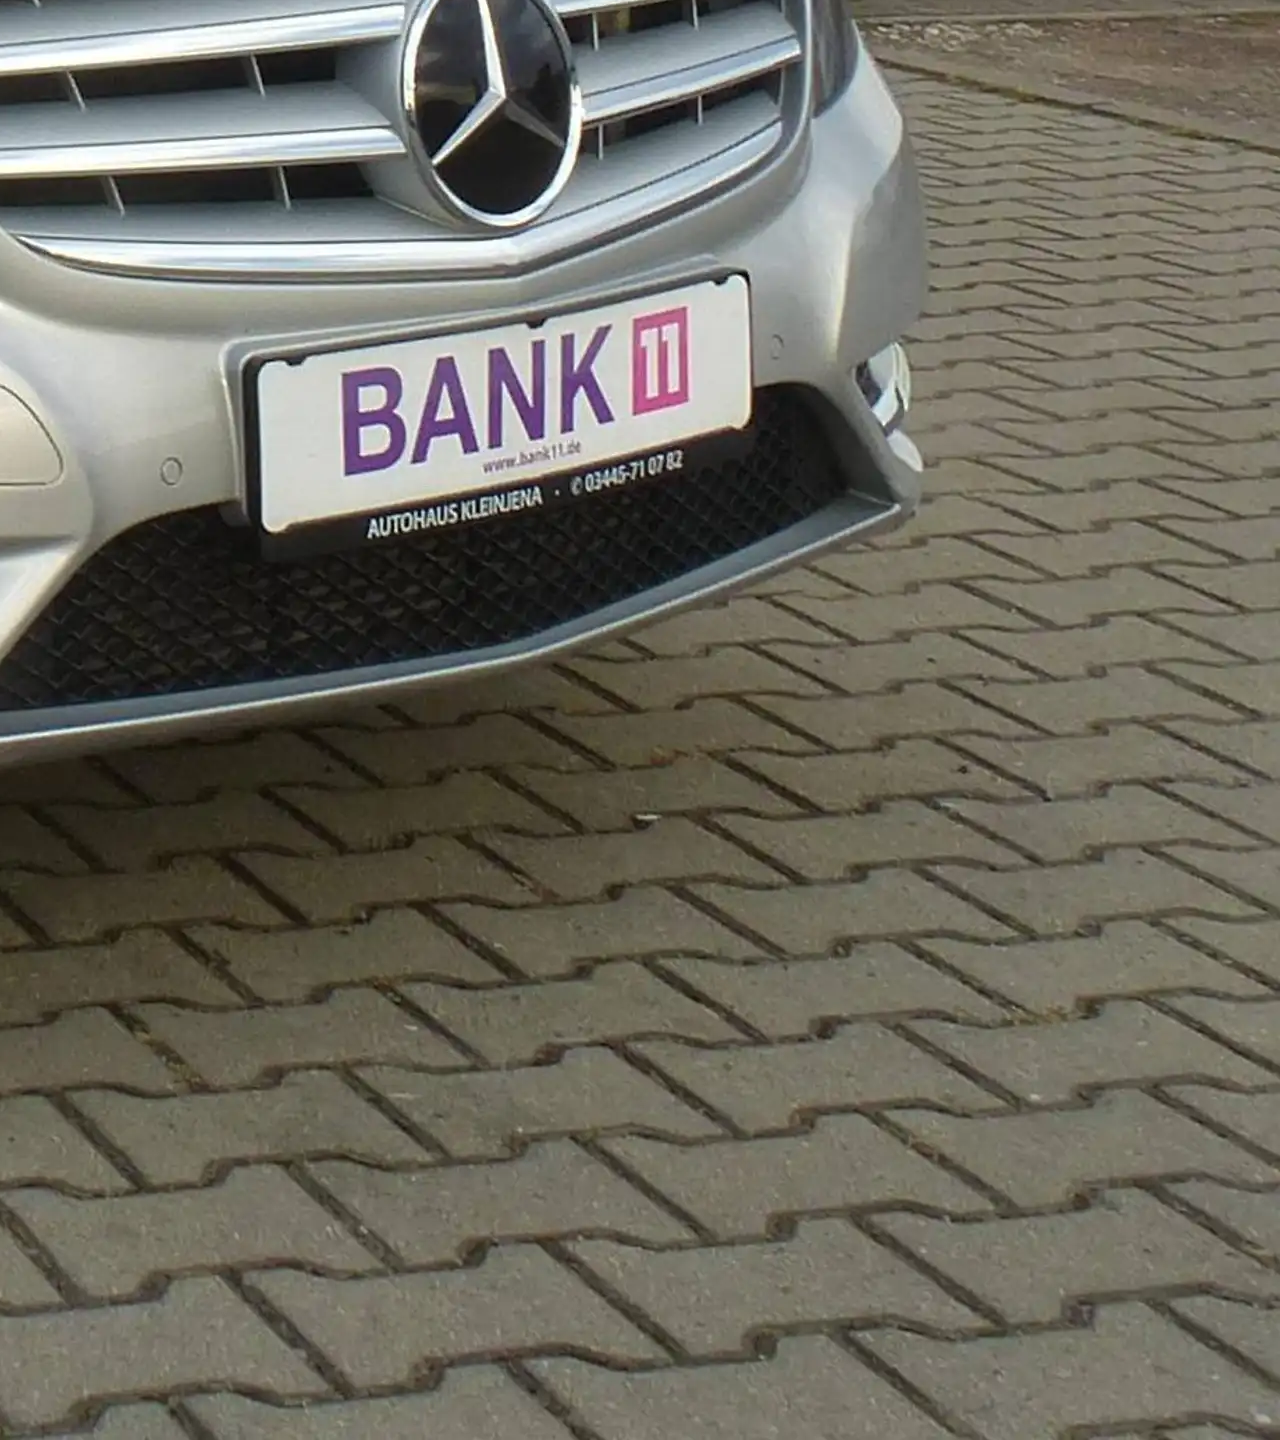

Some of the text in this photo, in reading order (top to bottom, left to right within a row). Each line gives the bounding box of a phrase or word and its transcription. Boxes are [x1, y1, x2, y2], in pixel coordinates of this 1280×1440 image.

[341, 318, 682, 477] BANK 11
[482, 439, 582, 475] www.bank11.de
[367, 503, 459, 539] AUTOHAUS
[460, 486, 544, 522] KLEINJENA
